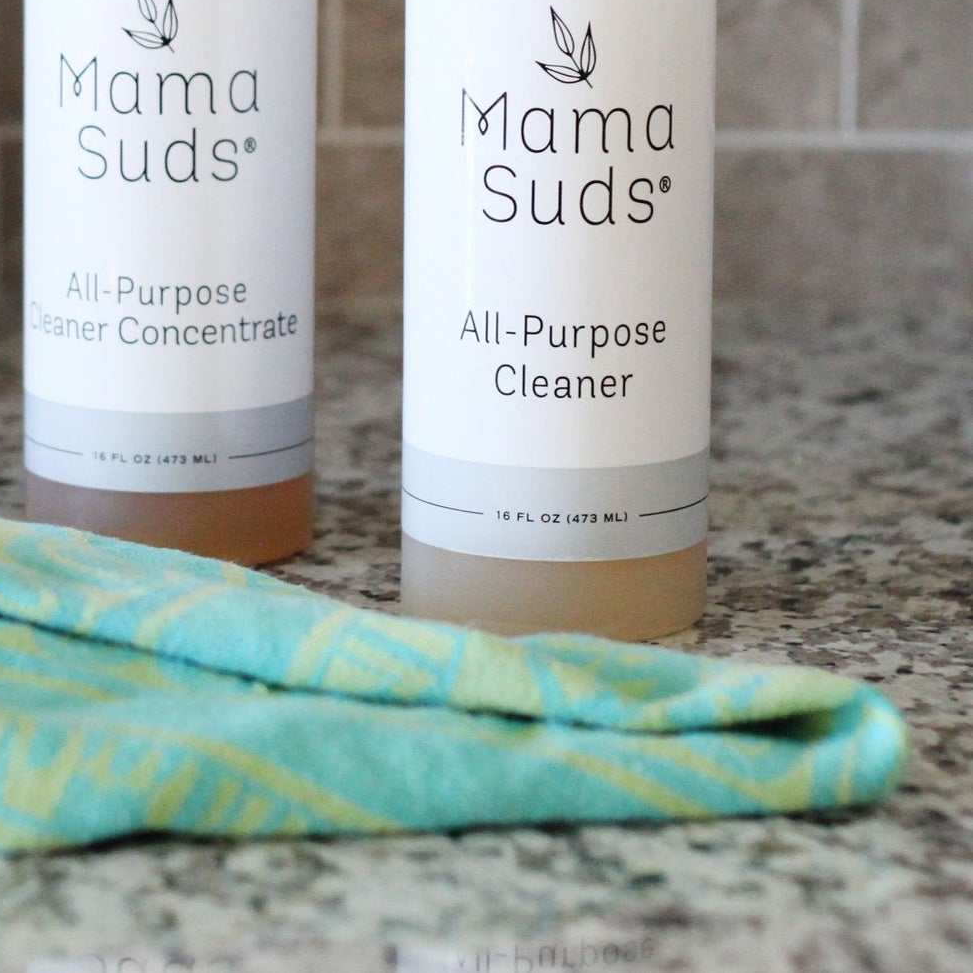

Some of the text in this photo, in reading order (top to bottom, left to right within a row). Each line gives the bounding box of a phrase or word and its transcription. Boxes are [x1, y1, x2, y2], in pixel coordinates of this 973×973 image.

[60, 53, 260, 115] Mama
[461, 88, 675, 154] Mama
[67, 272, 247, 315] All-Purpose
[30, 301, 298, 346] Cleaner Concentrate
[460, 310, 666, 359] All-Purpose
[495, 363, 633, 400] Cleaner
[93, 451, 217, 465] 16 FL OZ (473 ML)
[496, 510, 628, 525] 16 FL OZ (473 ML)
